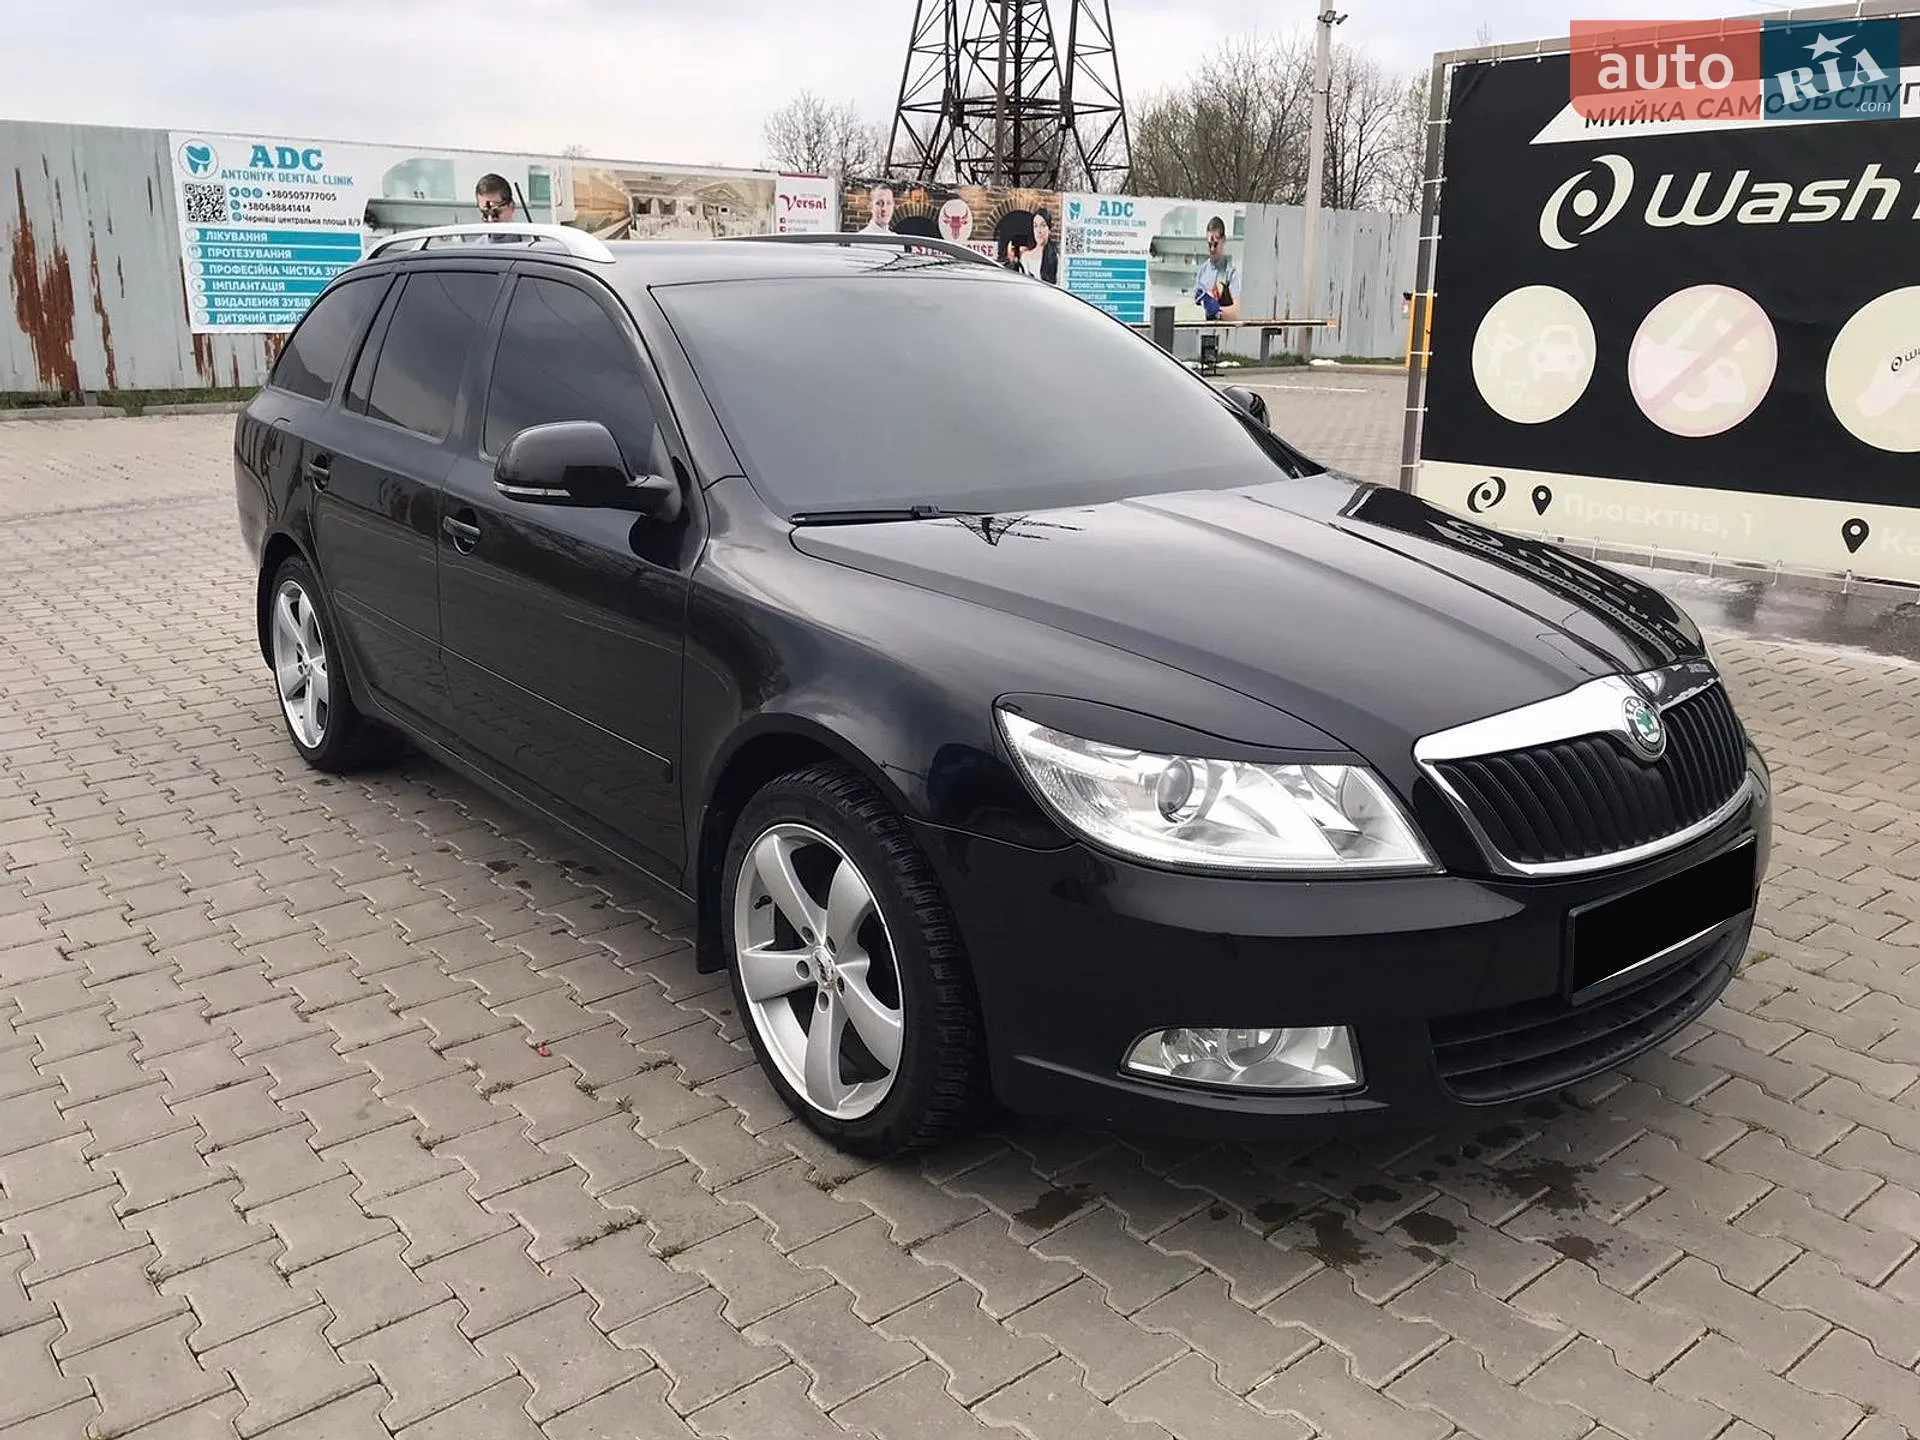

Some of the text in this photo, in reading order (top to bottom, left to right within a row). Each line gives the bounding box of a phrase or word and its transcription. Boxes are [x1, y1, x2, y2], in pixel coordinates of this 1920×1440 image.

[1585, 81, 1920, 129] МИЙКА САМООБСЛУГ
[248, 143, 325, 172] ADC
[278, 172, 319, 186] DENTAL
[322, 174, 355, 187] CLINIK
[1644, 162, 1920, 228] Wash
[778, 193, 828, 212] Versal
[1098, 200, 1135, 217] ADC
[206, 230, 269, 243] ЛІКУВАННЯ
[208, 247, 293, 260] ПРОТЕЗУВАННЯ
[209, 263, 279, 277] ПРОФЕСІЙНА
[282, 265, 322, 277] ЧИСТКА
[212, 280, 286, 292] ІМПЛАНТАЦІЯ
[214, 296, 311, 308] ВИДАЛЕННЯ ЗУБІВ
[216, 311, 266, 325] ДИТЯЧИЙ
